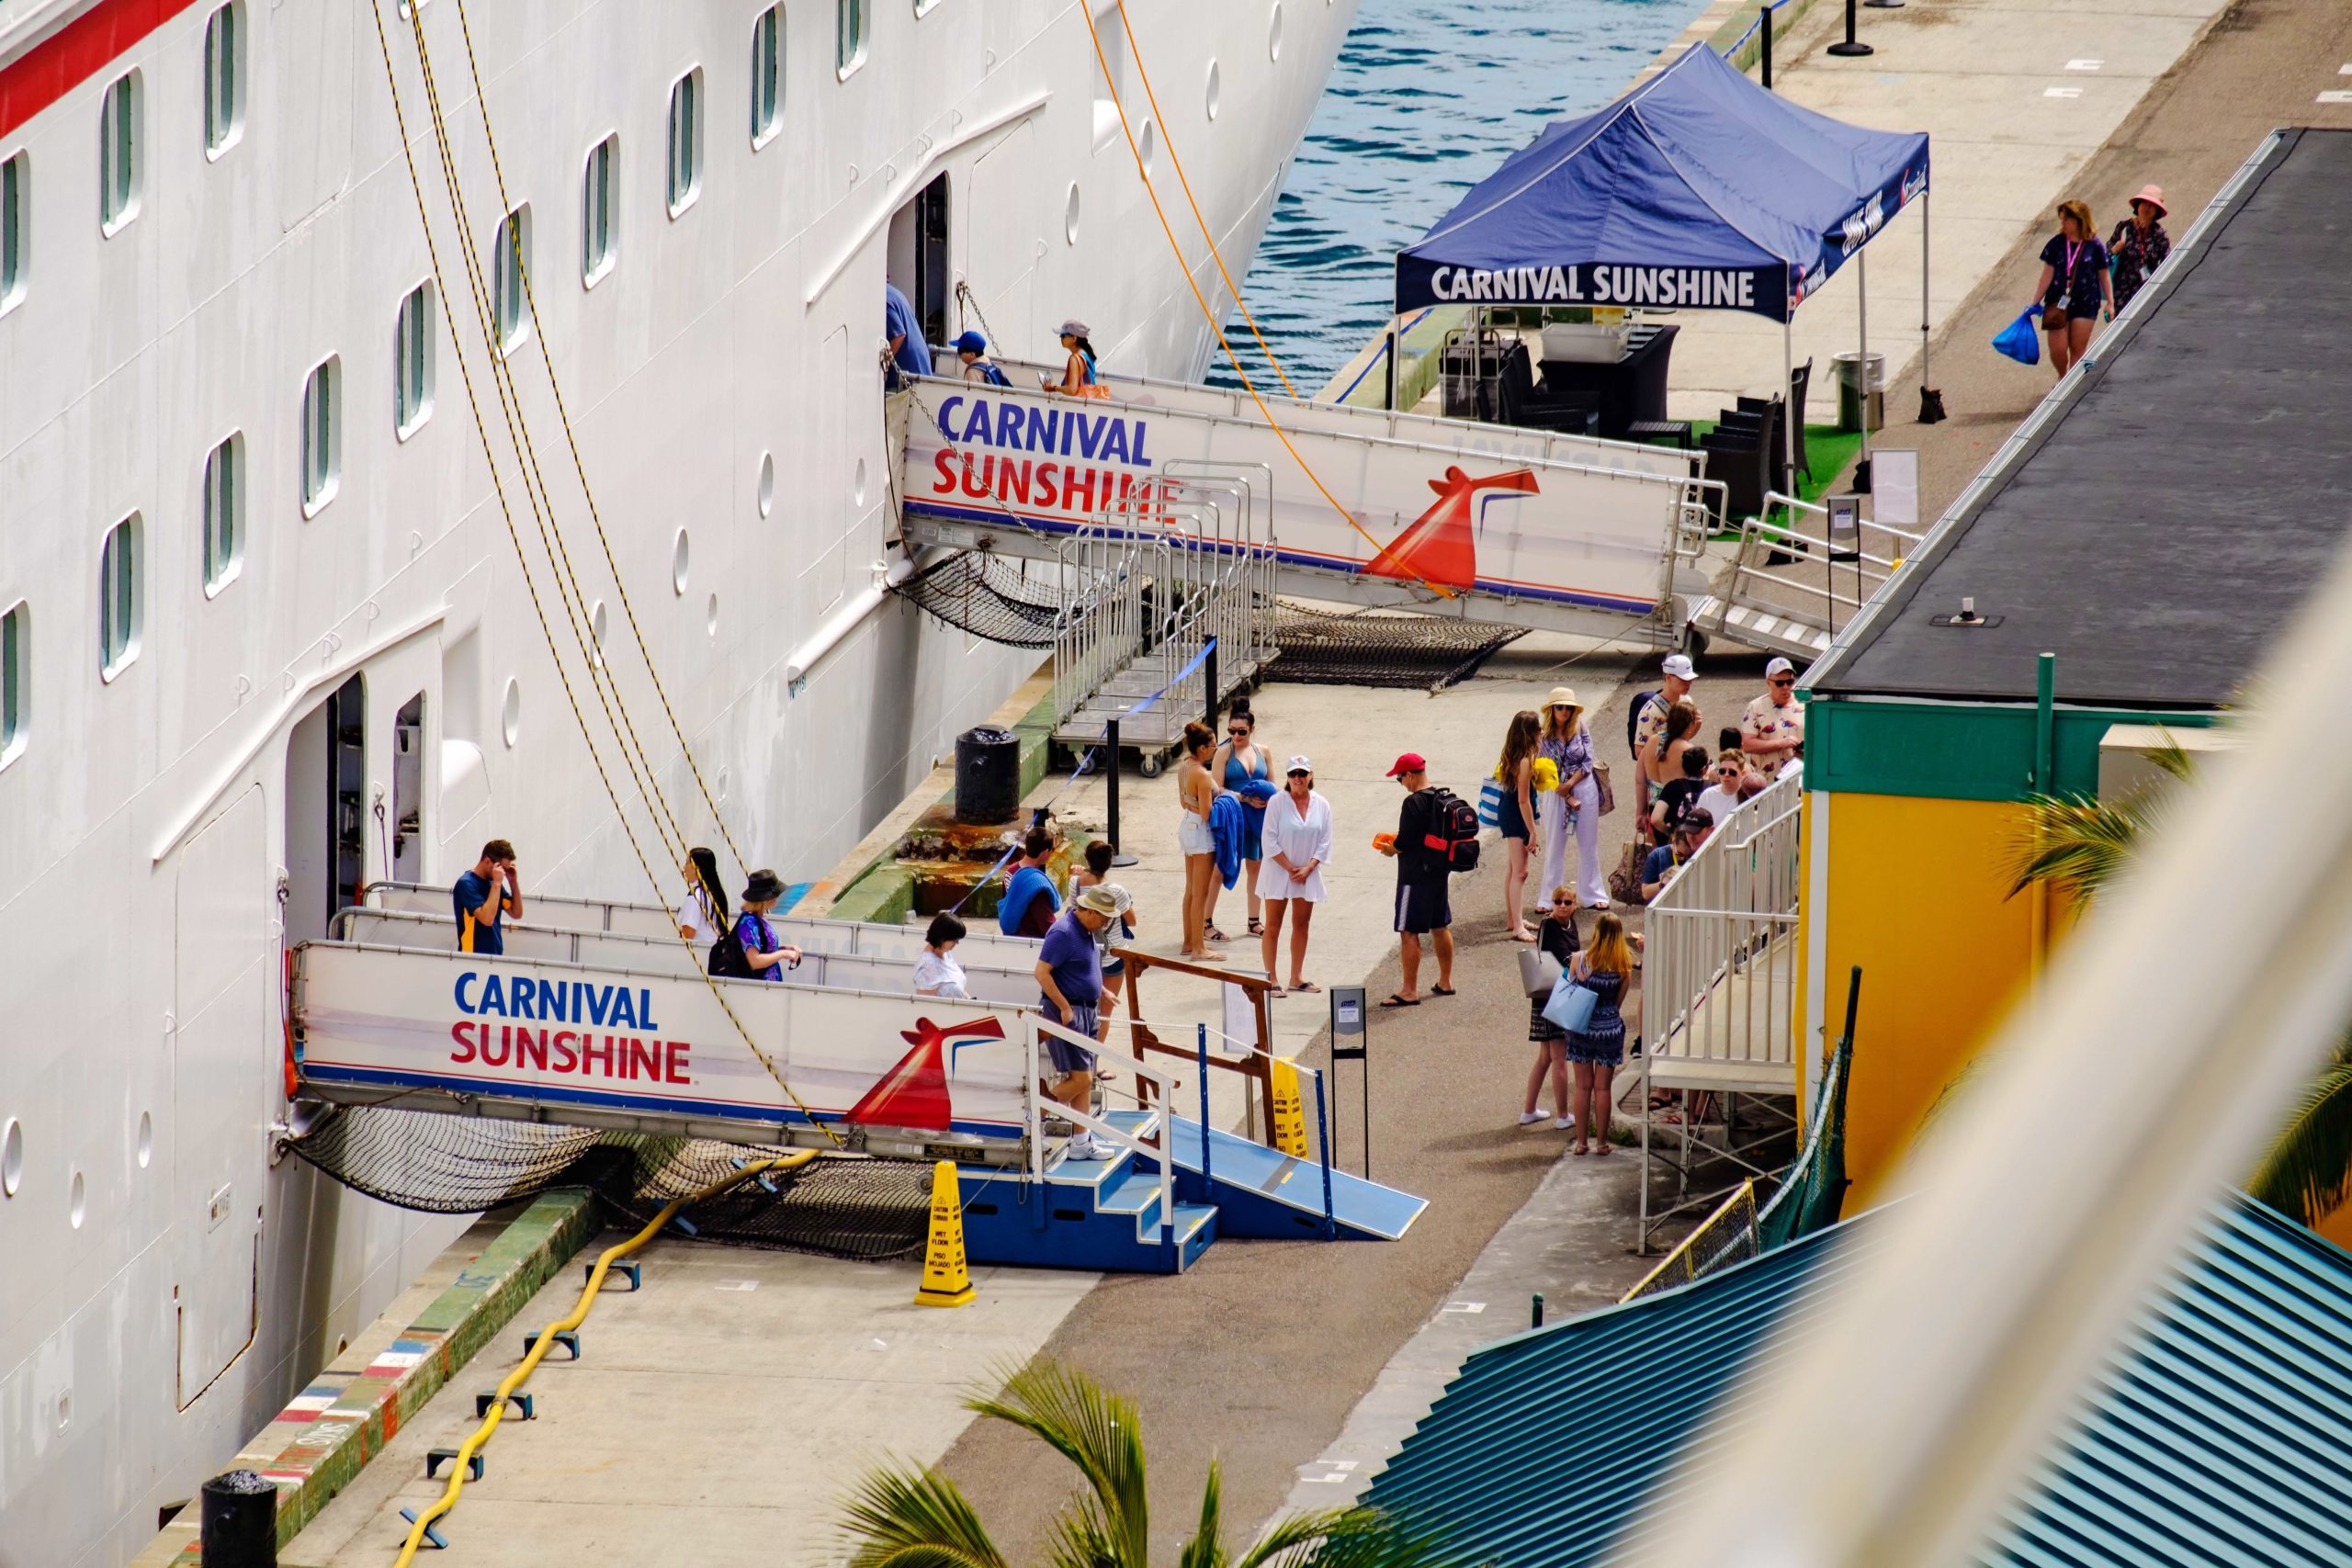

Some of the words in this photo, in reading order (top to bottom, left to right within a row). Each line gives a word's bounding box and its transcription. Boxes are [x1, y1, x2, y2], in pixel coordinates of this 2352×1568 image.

[1431, 266, 1583, 300] CARNIVAL
[1593, 266, 1755, 306] SUNSHINE
[938, 396, 1152, 467] CARNIVAL
[933, 448, 1181, 525] SUNSHINE
[454, 972, 658, 1031] CARNIVAL
[450, 1021, 691, 1085] SUNSHINE
